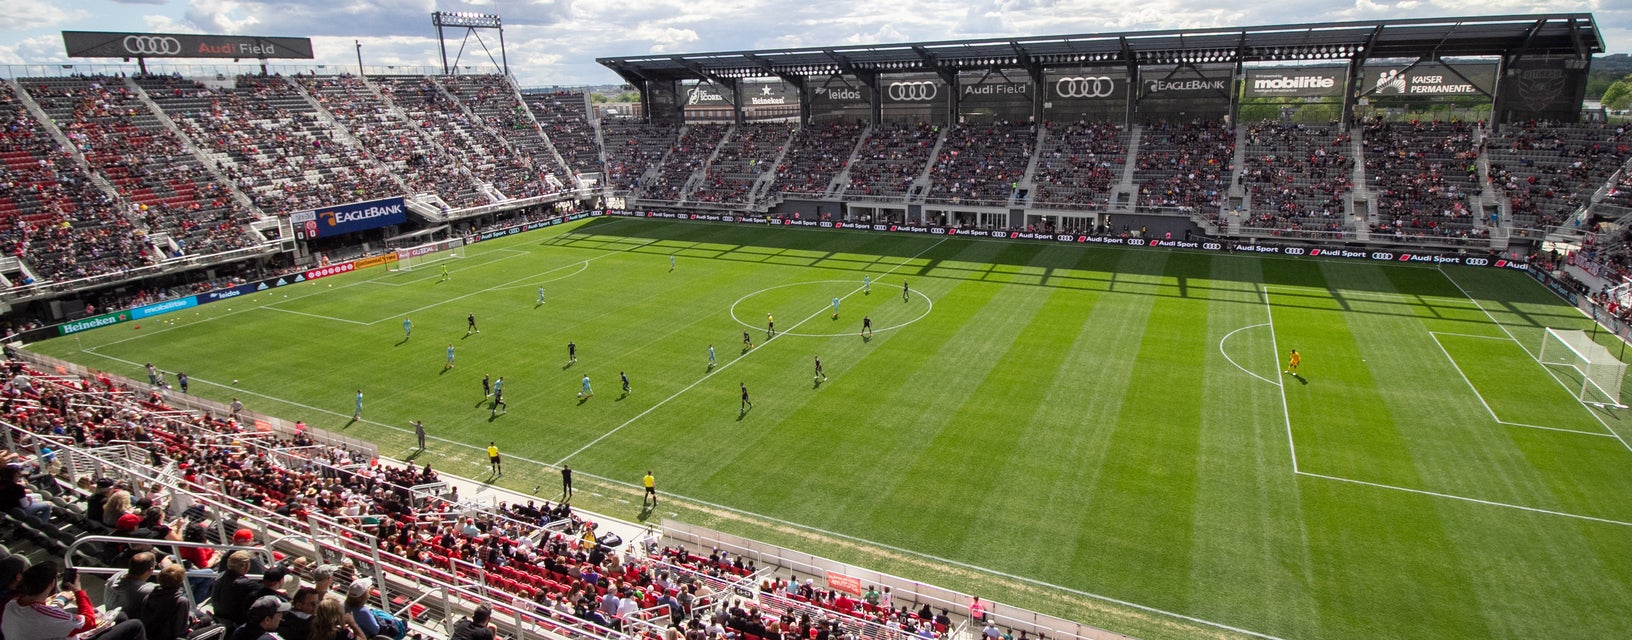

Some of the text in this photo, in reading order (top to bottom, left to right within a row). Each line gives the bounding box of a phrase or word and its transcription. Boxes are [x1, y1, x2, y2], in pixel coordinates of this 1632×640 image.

[198, 42, 275, 54] Audi Field
[1254, 76, 1334, 89] mobilitie
[1411, 75, 1443, 84] KAISER
[965, 84, 1026, 95] Audi Field
[1410, 84, 1472, 93] PERMANENTE
[828, 88, 861, 100] leidos
[752, 97, 785, 105] Heineken
[970, 229, 988, 237] Sport
[1034, 233, 1053, 241] Sport
[1103, 236, 1123, 245] Sport
[1176, 241, 1198, 249] Sport
[1236, 244, 1279, 254] Audi Sport
[1319, 249, 1367, 260] Audi Sport
[1410, 254, 1460, 265] Audi Sport
[1505, 260, 1529, 271] Audi
[218, 289, 241, 299] leidos
[144, 299, 187, 314] mobilitie
[63, 316, 116, 334] Heineken
